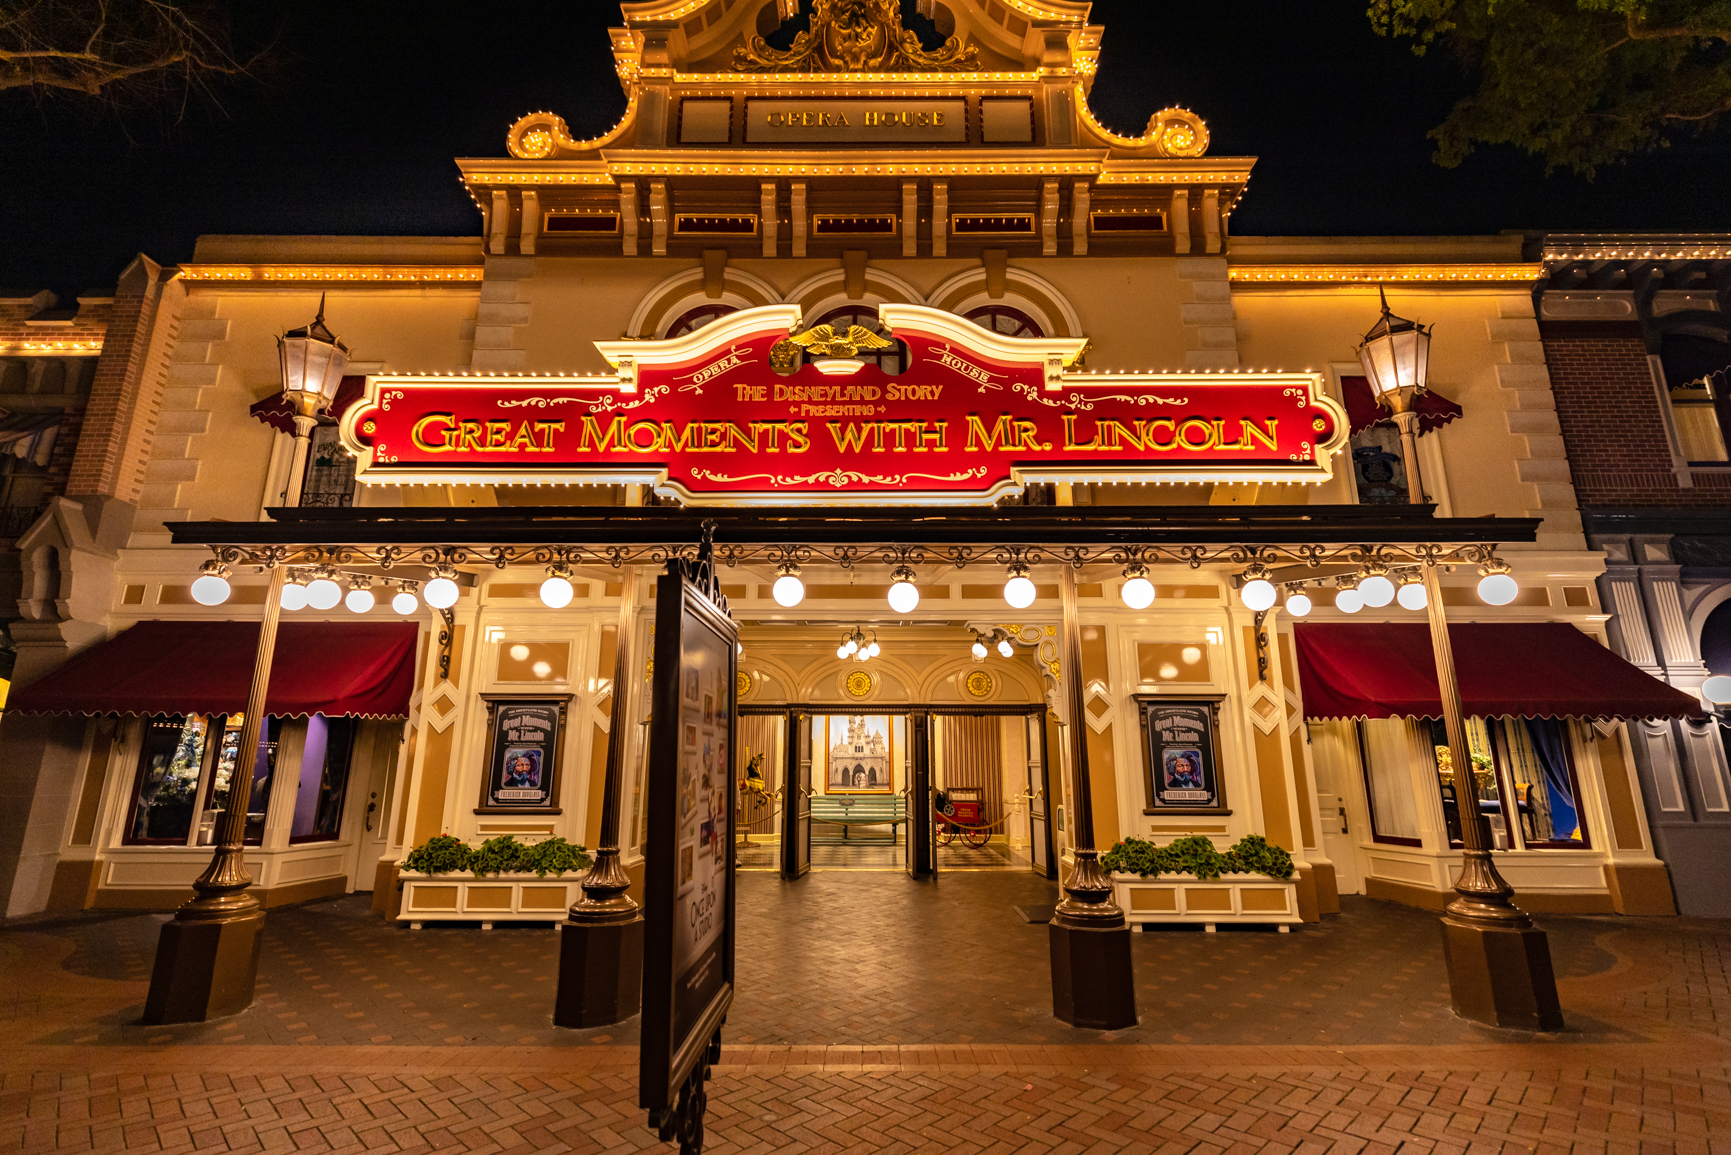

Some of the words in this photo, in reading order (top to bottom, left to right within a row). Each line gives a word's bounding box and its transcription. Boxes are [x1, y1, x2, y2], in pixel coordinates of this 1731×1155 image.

[767, 111, 850, 127] OPERA
[863, 111, 946, 127] HOUSE
[693, 355, 741, 383] OPERA
[941, 354, 990, 383] HOUSE
[733, 384, 767, 401] THE
[774, 384, 880, 401] DISNEYLAND
[886, 383, 943, 400] STORY
[801, 403, 875, 416] PRESENTING
[411, 414, 565, 453] GREAT
[577, 415, 810, 453] MOMENTS
[826, 421, 949, 453] WITH
[964, 415, 1053, 452] MR.
[1061, 414, 1278, 452] LINCOLN
[502, 716, 521, 731] Great
[521, 715, 551, 731] Moments
[1155, 716, 1173, 731] Great
[1173, 715, 1205, 732] Moments
[520, 730, 544, 741] Lincoln
[1175, 730, 1200, 742] Lincoln
